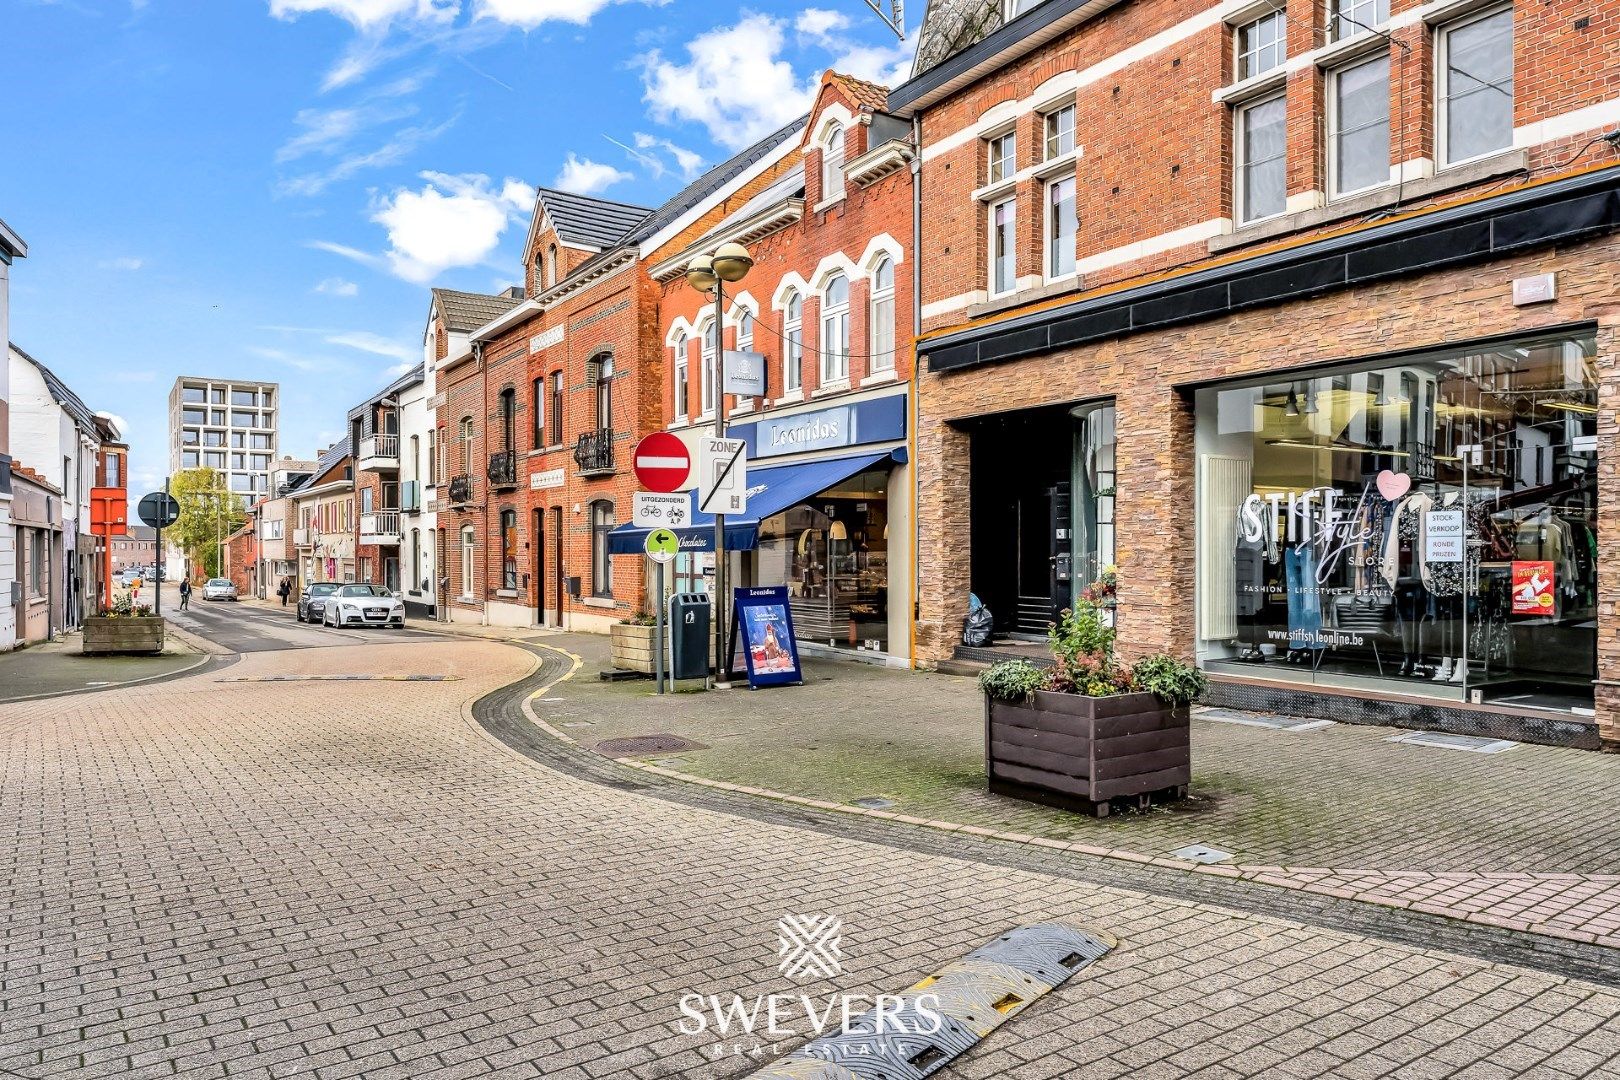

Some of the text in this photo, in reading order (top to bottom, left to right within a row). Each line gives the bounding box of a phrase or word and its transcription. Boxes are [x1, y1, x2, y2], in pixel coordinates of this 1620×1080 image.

[771, 417, 839, 447] Leonidas
[710, 441, 738, 453] ZONE
[641, 496, 685, 504] UITGEZONDERD
[1242, 489, 1344, 543] STIFF
[1429, 525, 1460, 533] VERKOOP
[1348, 556, 1396, 567] STORE
[1243, 585, 1396, 598] FASHION LIFESTYLE BEAUTY
[1267, 628, 1364, 646] www.stiffstyleonline.be
